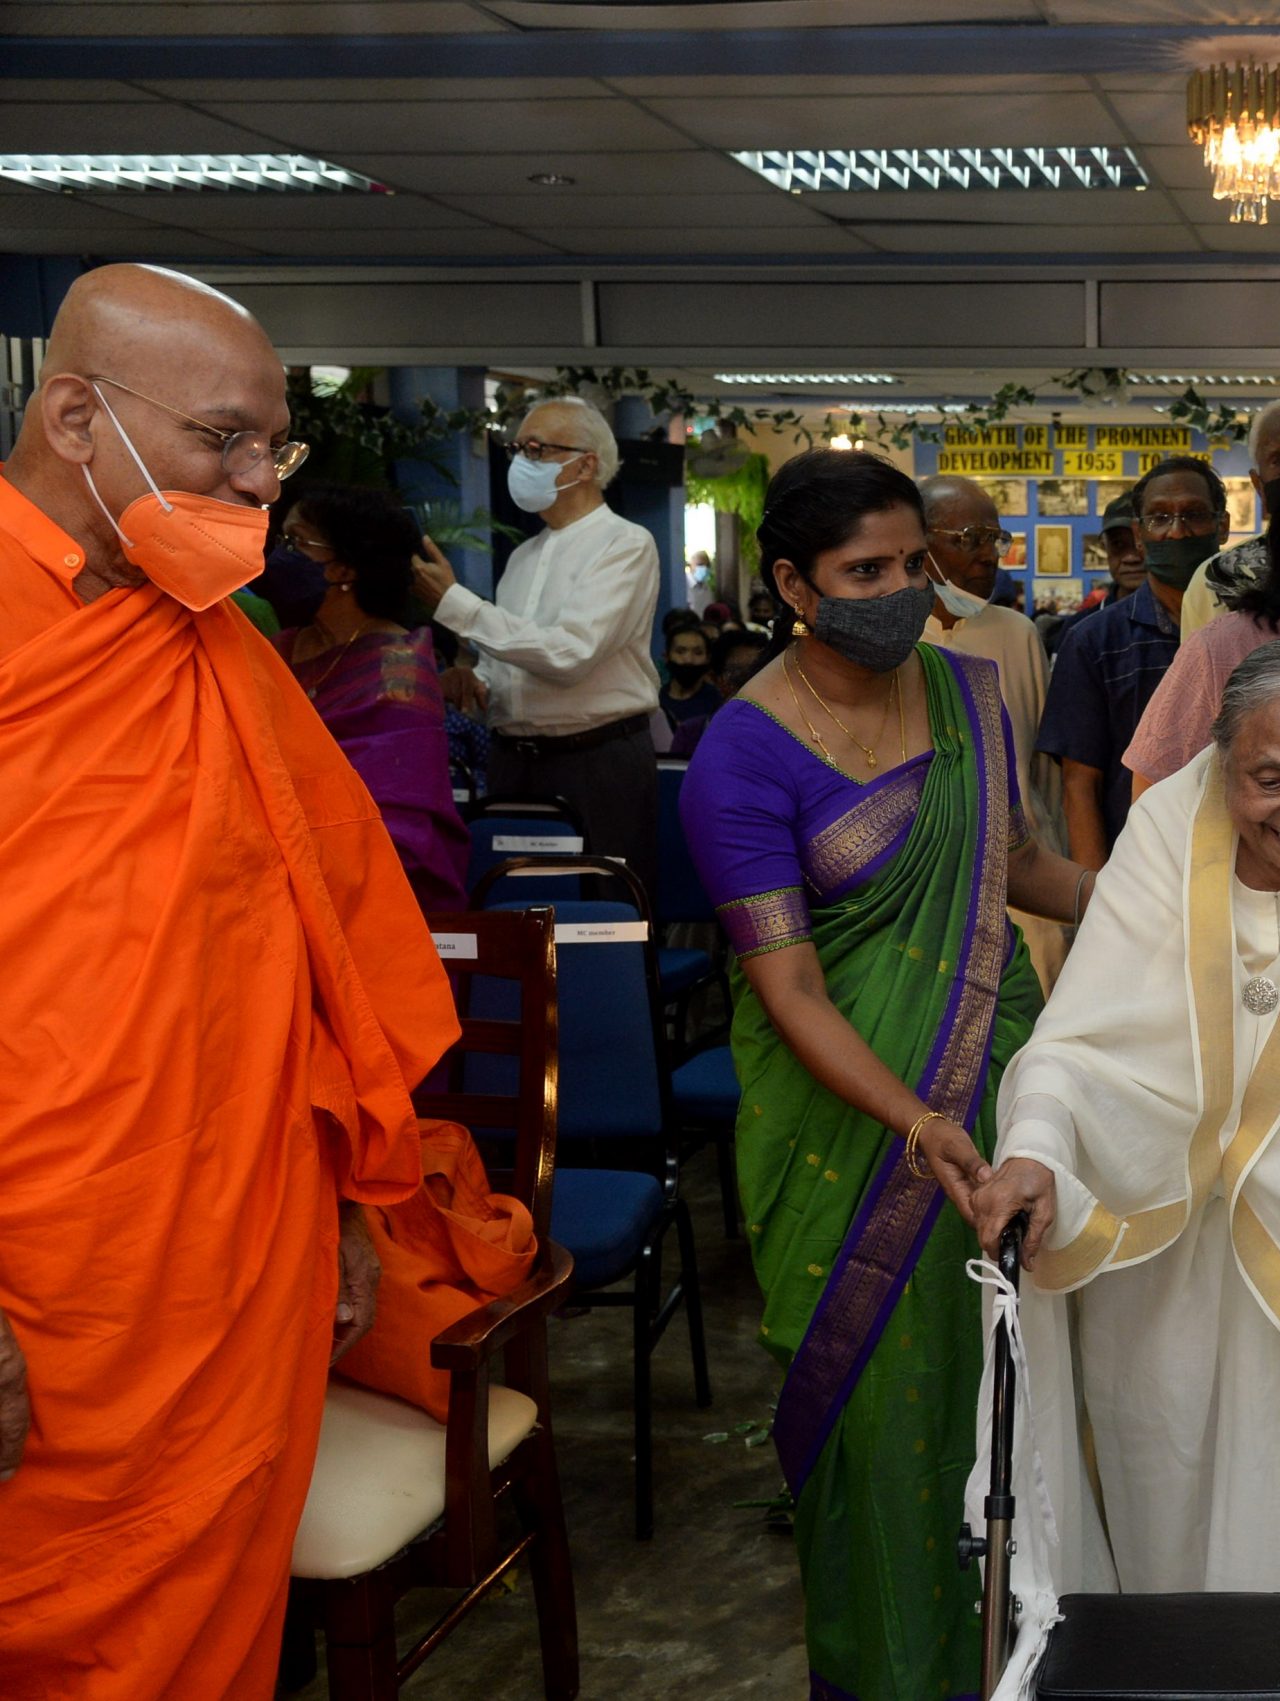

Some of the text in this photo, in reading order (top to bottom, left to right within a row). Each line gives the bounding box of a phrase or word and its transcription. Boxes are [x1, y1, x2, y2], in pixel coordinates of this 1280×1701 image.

[945, 426, 1189, 446] GROWTH OF THE PROMINENT
[939, 451, 1053, 471] DEVELOPMENT
[1076, 453, 1116, 471] 1955
[1140, 453, 1162, 472] TO
